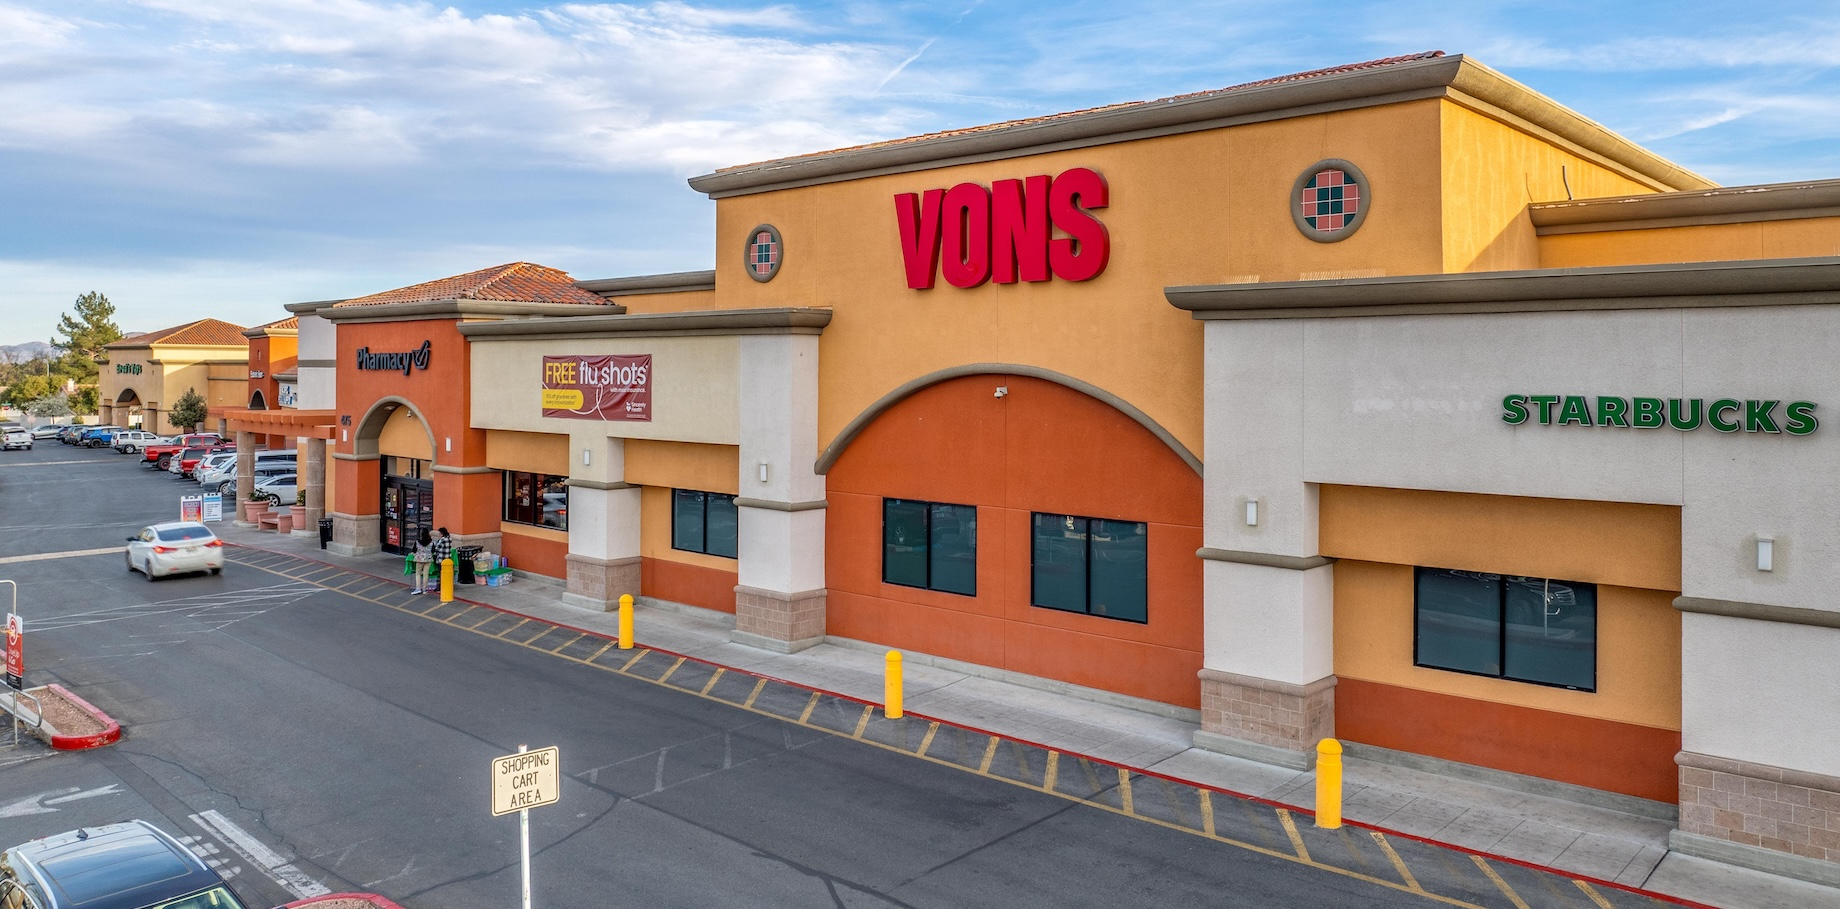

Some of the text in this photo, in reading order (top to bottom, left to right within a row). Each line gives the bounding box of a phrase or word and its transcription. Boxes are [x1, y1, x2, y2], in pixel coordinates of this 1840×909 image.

[893, 167, 1110, 290] VONS
[356, 347, 413, 376] Pharmacy
[545, 362, 577, 385] FREE
[579, 361, 599, 385] flu
[1501, 393, 1819, 437] STARBUCKS
[501, 752, 549, 775] SHOPPING
[512, 771, 539, 789] CART
[510, 788, 542, 808] AREA
